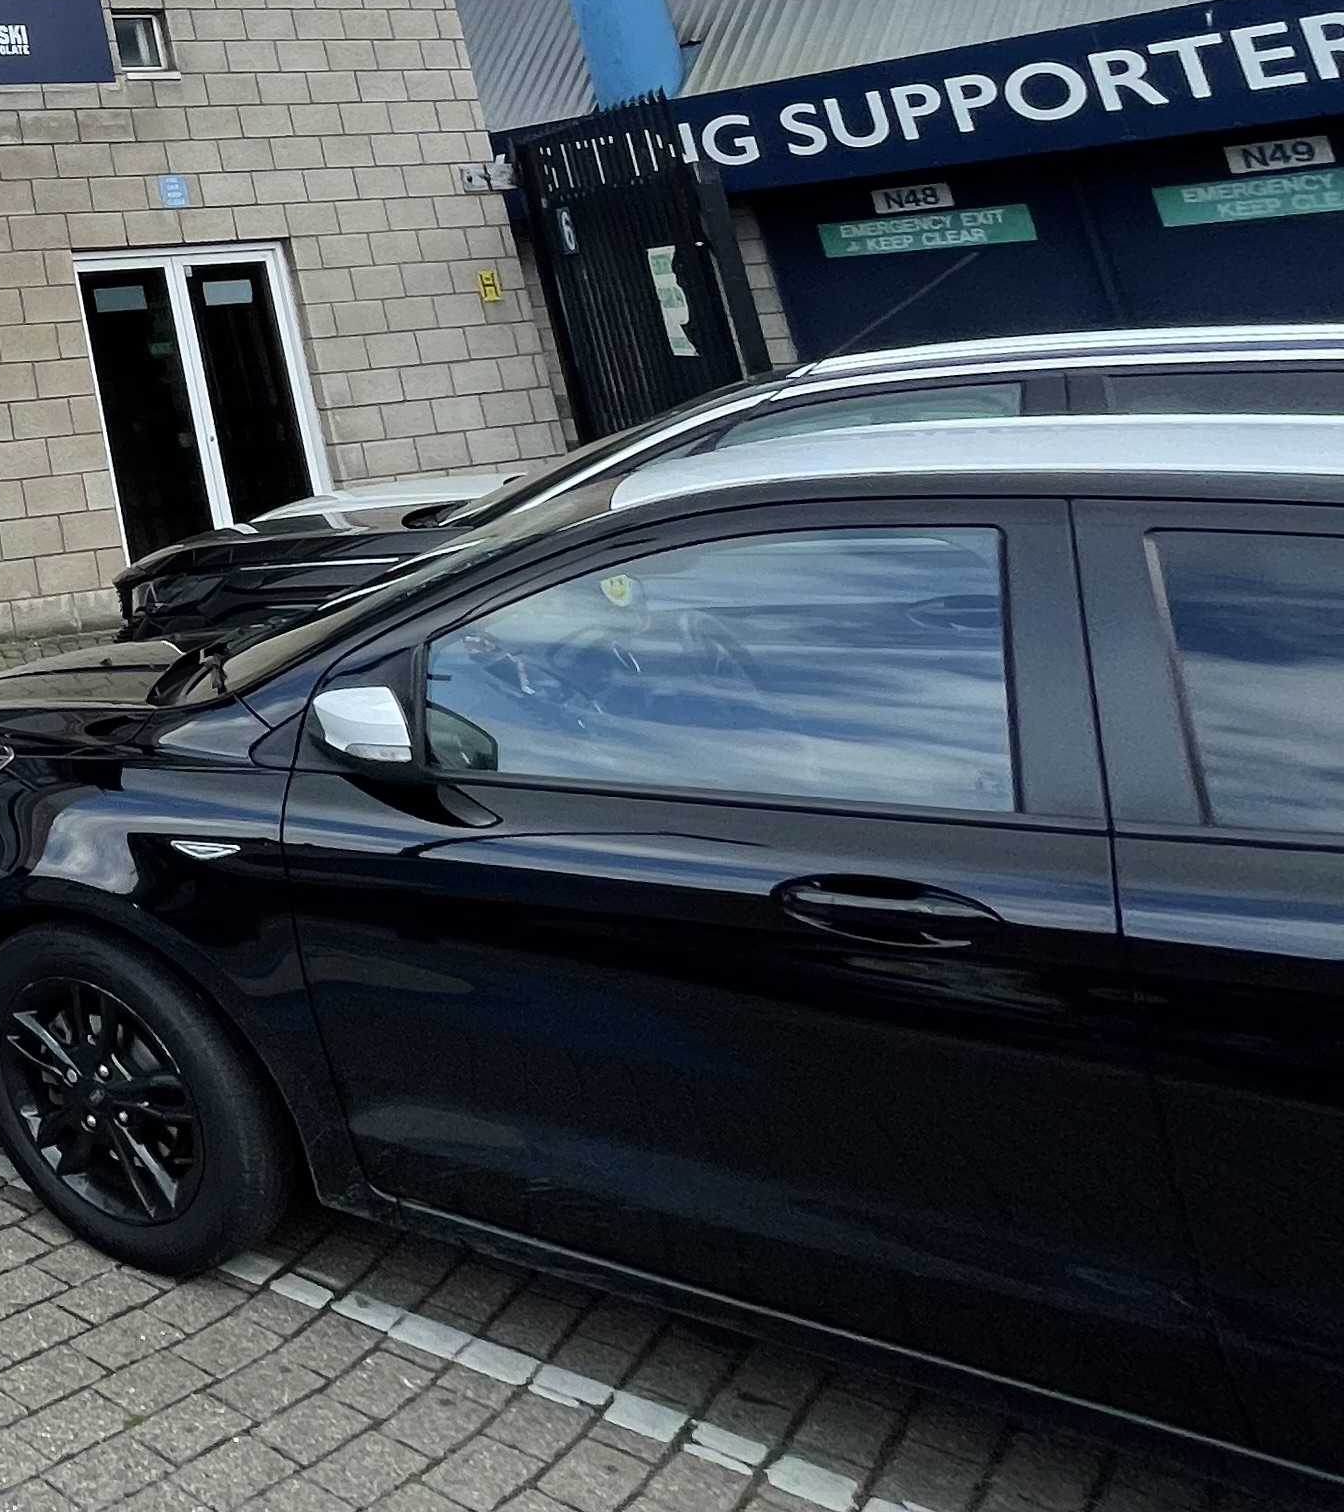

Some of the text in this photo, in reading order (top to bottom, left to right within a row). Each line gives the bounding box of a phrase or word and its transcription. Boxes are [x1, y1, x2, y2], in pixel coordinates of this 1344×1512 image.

[1242, 141, 1316, 169] N49
[883, 186, 941, 209] N48
[1182, 173, 1333, 203] EMERGENCY
[1217, 197, 1281, 218] KEEP
[562, 211, 575, 250] 6
[839, 209, 1004, 238] EMERGENCY EXIT
[866, 228, 987, 251] KEEP CLEAR
